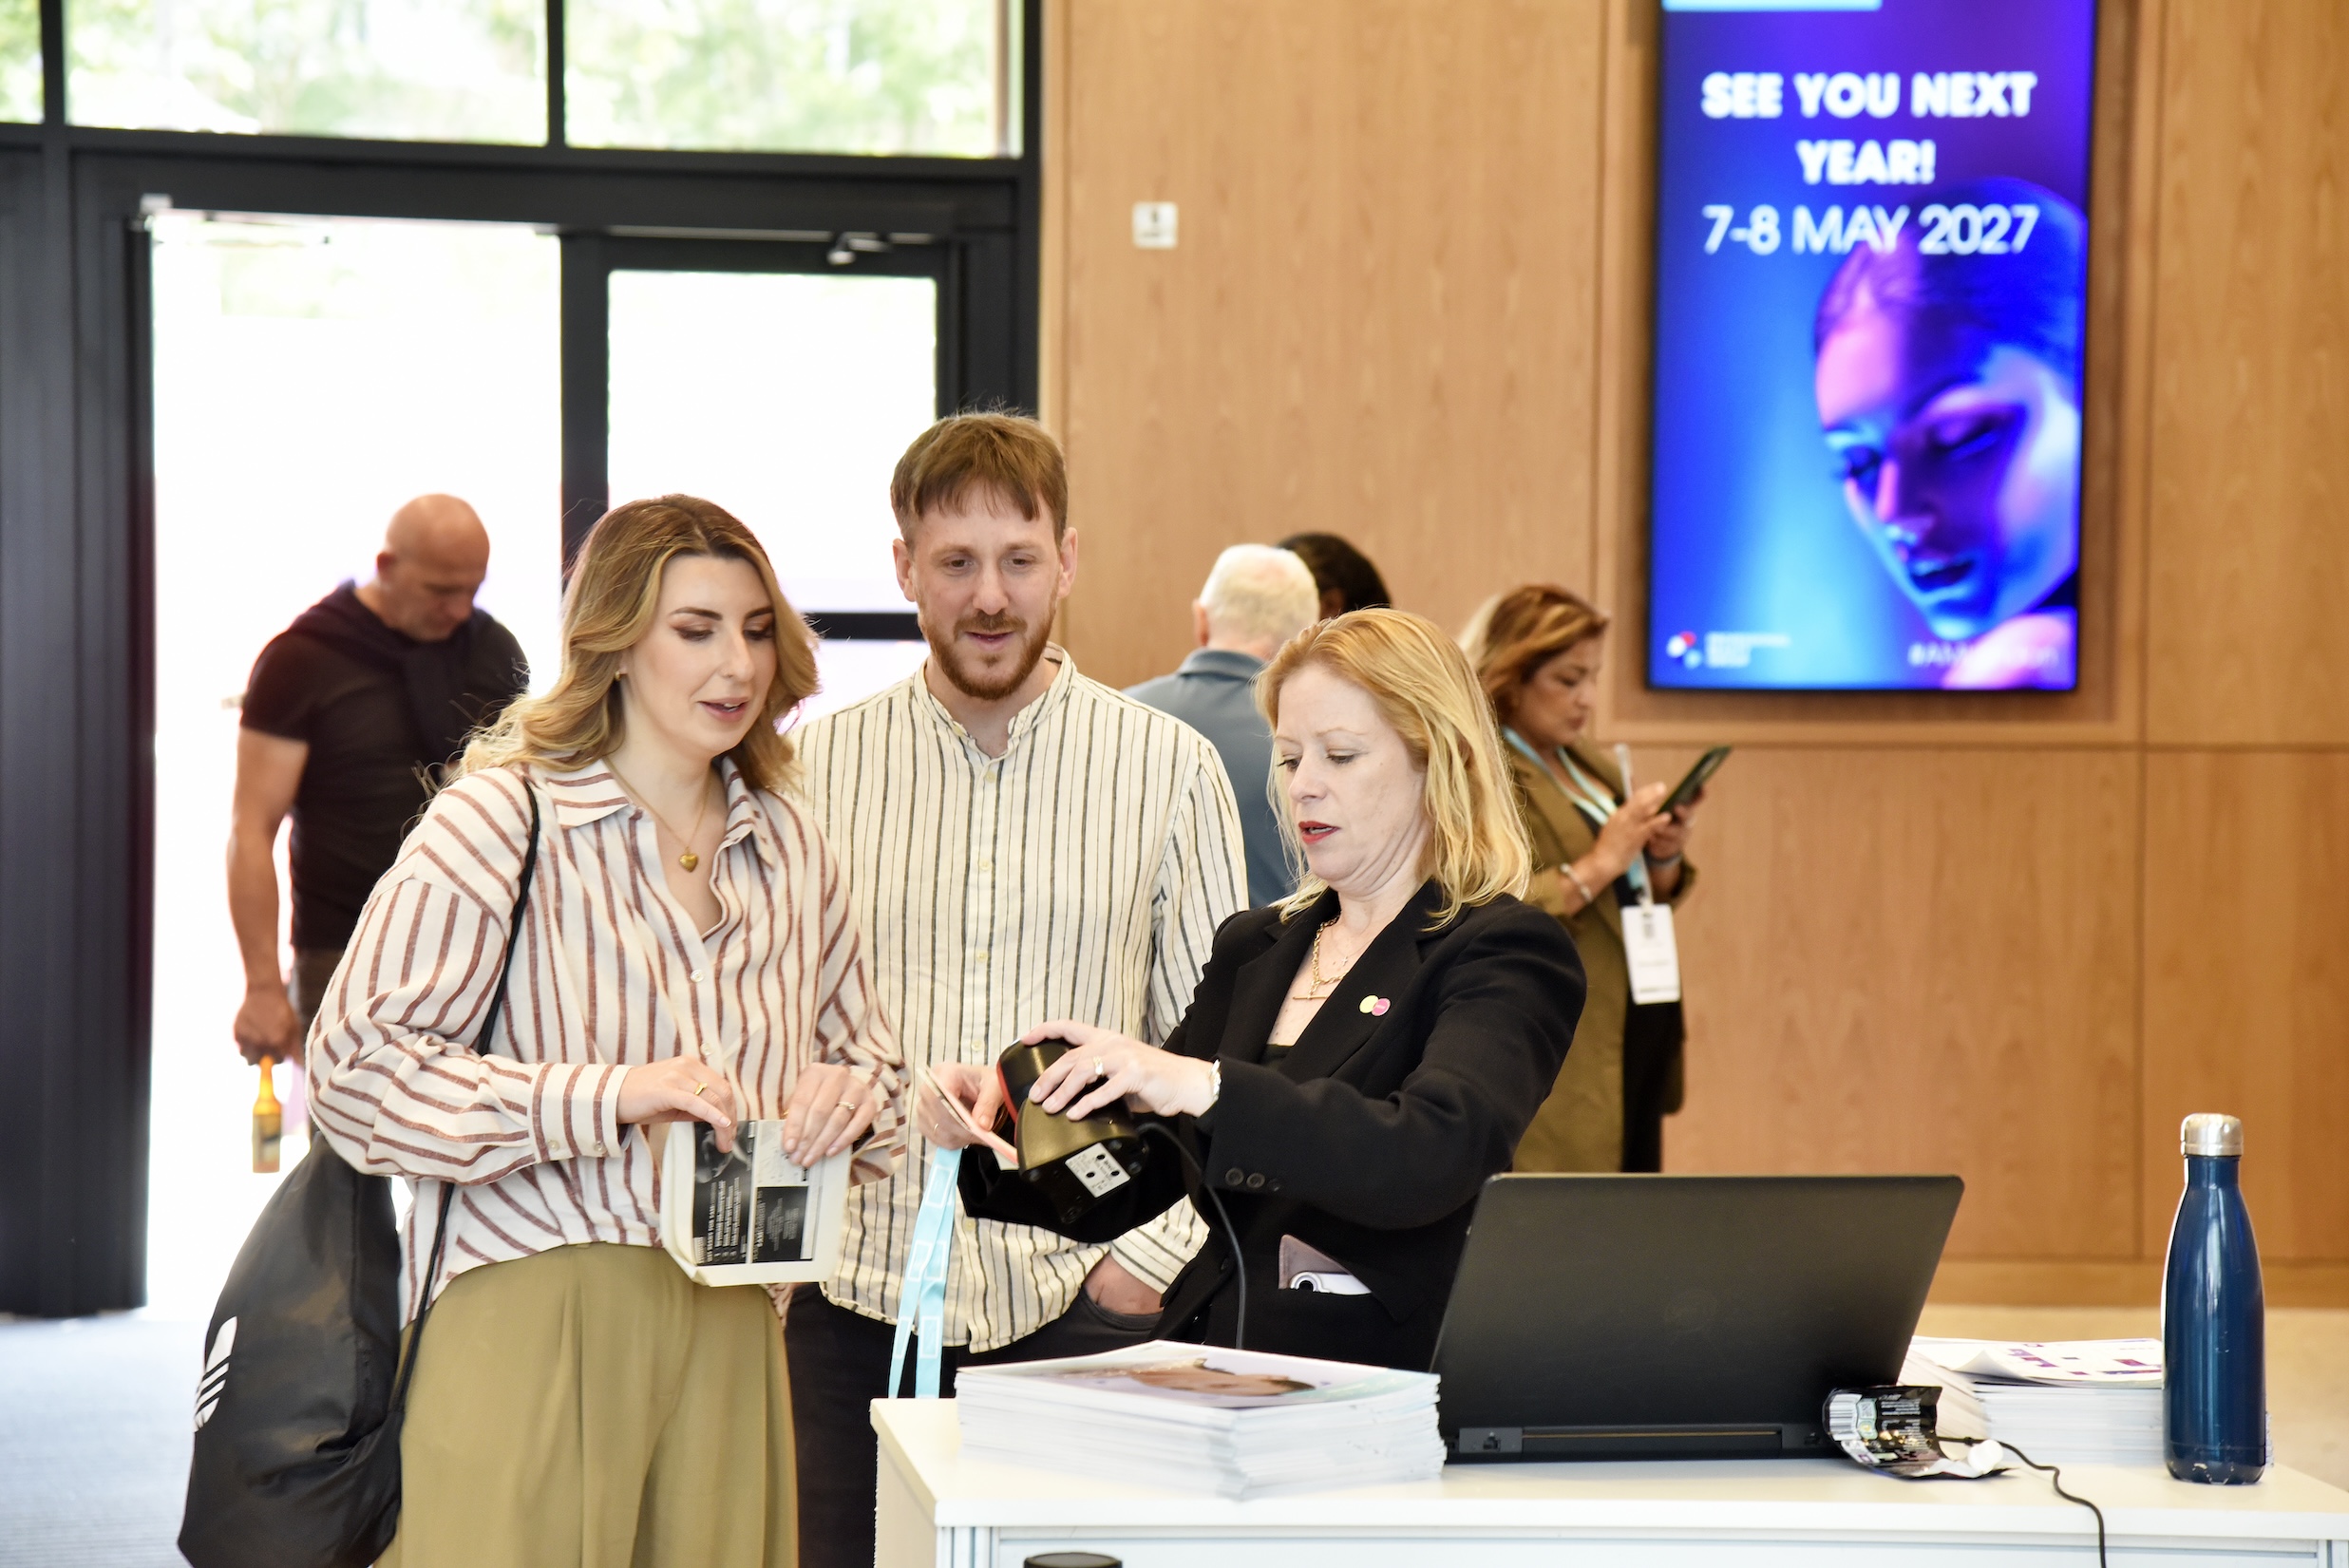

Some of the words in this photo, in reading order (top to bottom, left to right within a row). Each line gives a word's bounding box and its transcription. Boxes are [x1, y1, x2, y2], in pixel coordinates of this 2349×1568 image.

[1701, 71, 1784, 119] SEE
[1792, 71, 1900, 119] YOU
[1910, 71, 2037, 118] NEXT
[1795, 139, 1936, 185] YEAR!
[1701, 204, 1781, 255] 7-8
[1791, 204, 1909, 255] MAY
[1918, 203, 2040, 255] 2027
